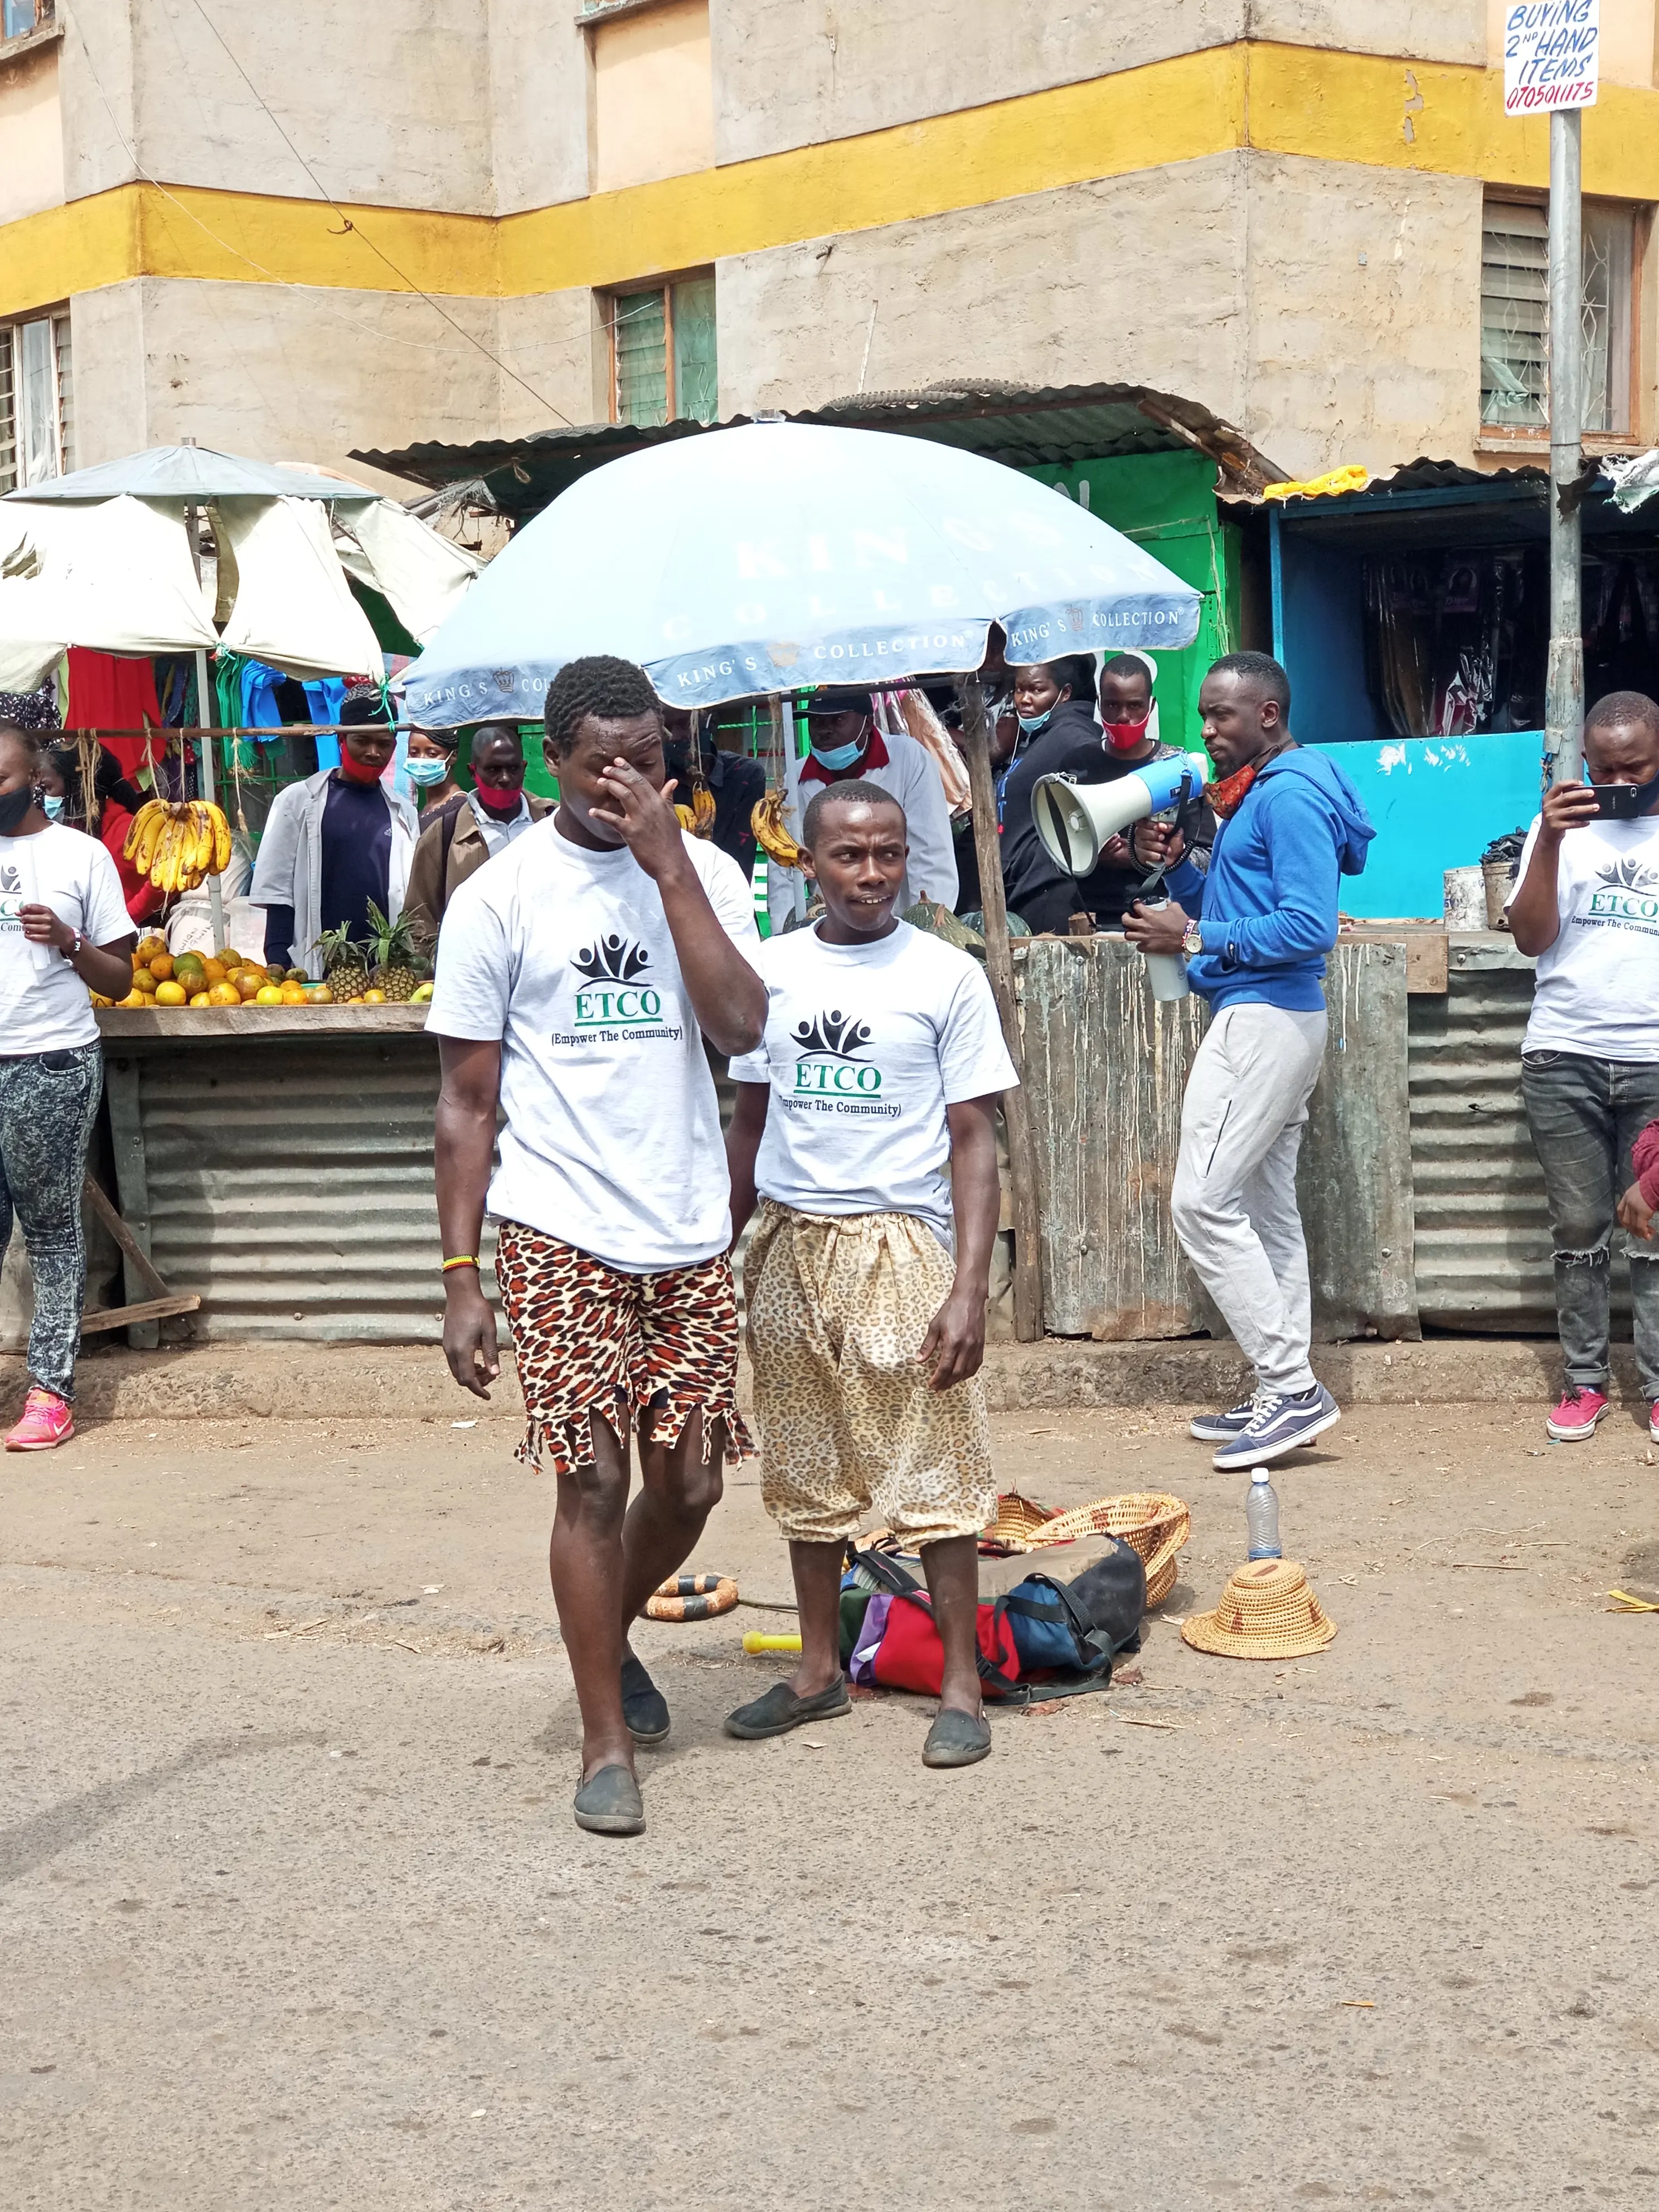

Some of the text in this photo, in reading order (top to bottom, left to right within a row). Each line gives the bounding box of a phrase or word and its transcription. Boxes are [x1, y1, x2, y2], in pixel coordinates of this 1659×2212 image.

[1507, 0, 1592, 31] BUYING
[1535, 27, 1598, 57] HAND
[1519, 52, 1593, 85] ITEMS
[1506, 81, 1594, 109] 0705011175
[1590, 894, 1658, 917] ETCO
[1607, 919, 1622, 928] The
[1624, 922, 1659, 937] Commun
[574, 989, 661, 1019] ETCO
[599, 1030, 619, 1042] The
[622, 1025, 682, 1041] Community)
[795, 1063, 881, 1092] ETCO
[814, 1099, 833, 1112] The
[836, 1102, 901, 1117] Community)
